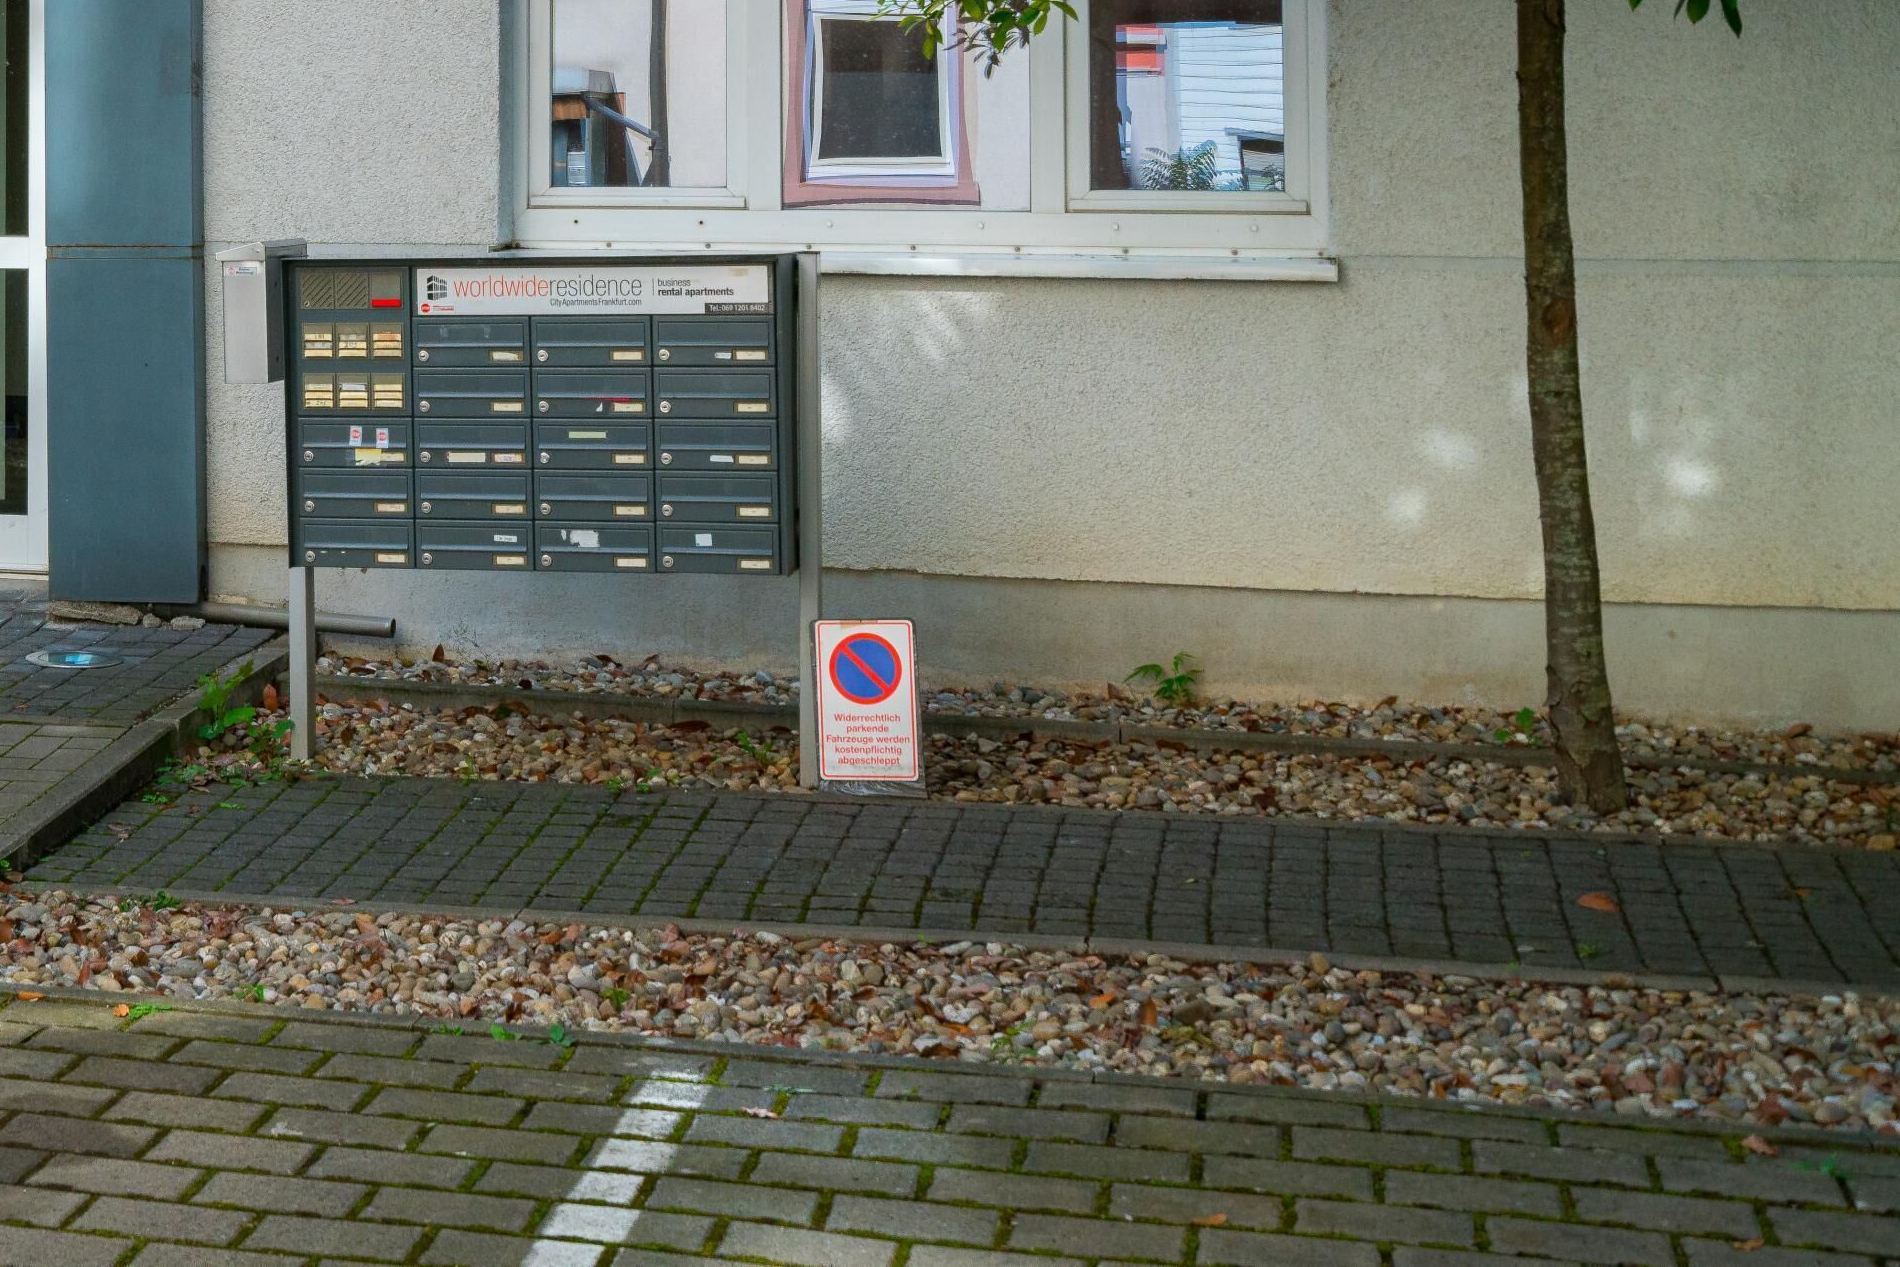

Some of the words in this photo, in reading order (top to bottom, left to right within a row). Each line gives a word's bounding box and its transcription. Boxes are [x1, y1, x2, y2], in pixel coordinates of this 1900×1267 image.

[453, 275, 642, 297] worldwideresidence
[657, 278, 691, 287] business
[658, 288, 682, 296] rental
[685, 287, 734, 297] apartments
[734, 304, 748, 312] 1201
[834, 713, 901, 722] Widerrechtlich
[846, 725, 889, 733] parkende
[826, 735, 873, 744] Fahrzeuge
[835, 746, 902, 755] kostenpflichtig
[838, 757, 901, 765] abgeschleppt
